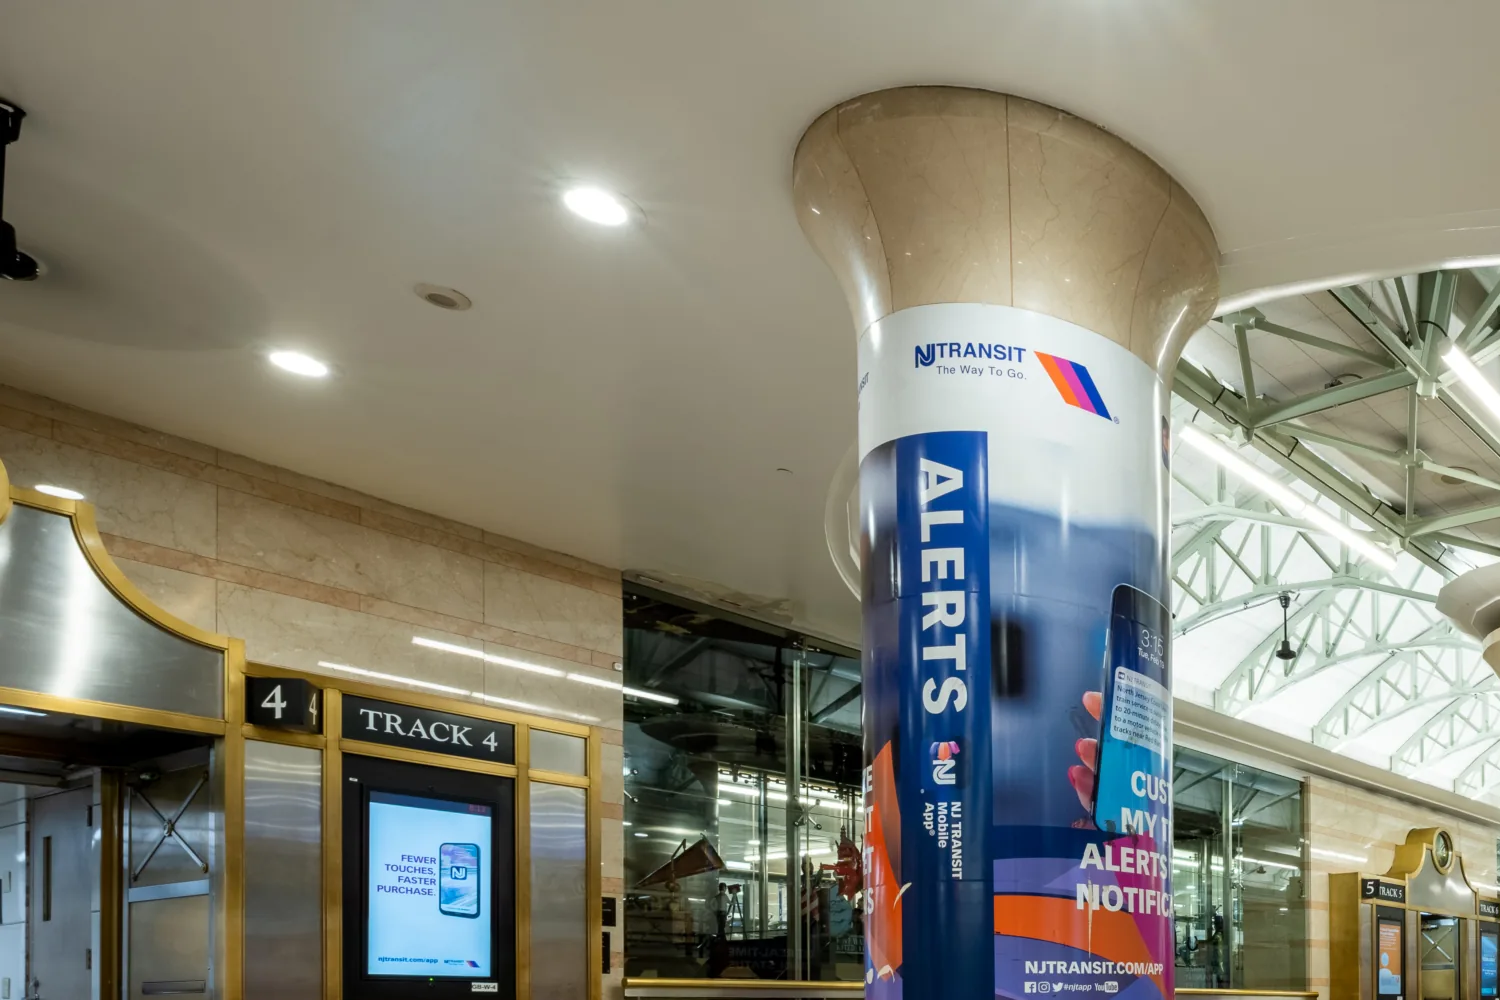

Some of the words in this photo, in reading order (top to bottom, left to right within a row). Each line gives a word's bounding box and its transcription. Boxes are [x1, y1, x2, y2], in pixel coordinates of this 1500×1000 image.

[936, 365, 956, 375] The
[960, 365, 984, 377] Way
[988, 366, 1003, 376] To
[1007, 368, 1027, 380] Go.
[920, 458, 967, 714] ALERTS
[1141, 629, 1164, 657] 3:15
[1150, 655, 1159, 666] Feb
[1117, 685, 1134, 697] North
[261, 684, 287, 719] 4
[1116, 695, 1131, 705] train
[309, 693, 317, 725] 4
[1114, 714, 1121, 722] to
[1127, 718, 1144, 730] motor
[360, 708, 473, 747] TRACK
[482, 732, 498, 752] 4
[1113, 724, 1132, 736] tracks
[951, 801, 961, 818] NJ
[938, 802, 948, 848] Mobile
[1121, 807, 1158, 838] MY
[951, 822, 962, 880] TRANSIT
[401, 854, 436, 865] FEWER
[1079, 843, 1167, 880] ALERTS
[385, 863, 436, 876] TOUCHES,
[398, 876, 436, 886] FASTER
[1366, 881, 1374, 895] 5
[377, 885, 436, 896] PURCHASE.
[1379, 886, 1398, 898] TRACK
[1398, 889, 1403, 899] 5
[1480, 904, 1494, 914] TRACK
[378, 956, 439, 964] njtransit.com/app
[1025, 961, 1163, 975] NJTRANSIT.COM/APP
[1064, 983, 1092, 992] #njtapp
